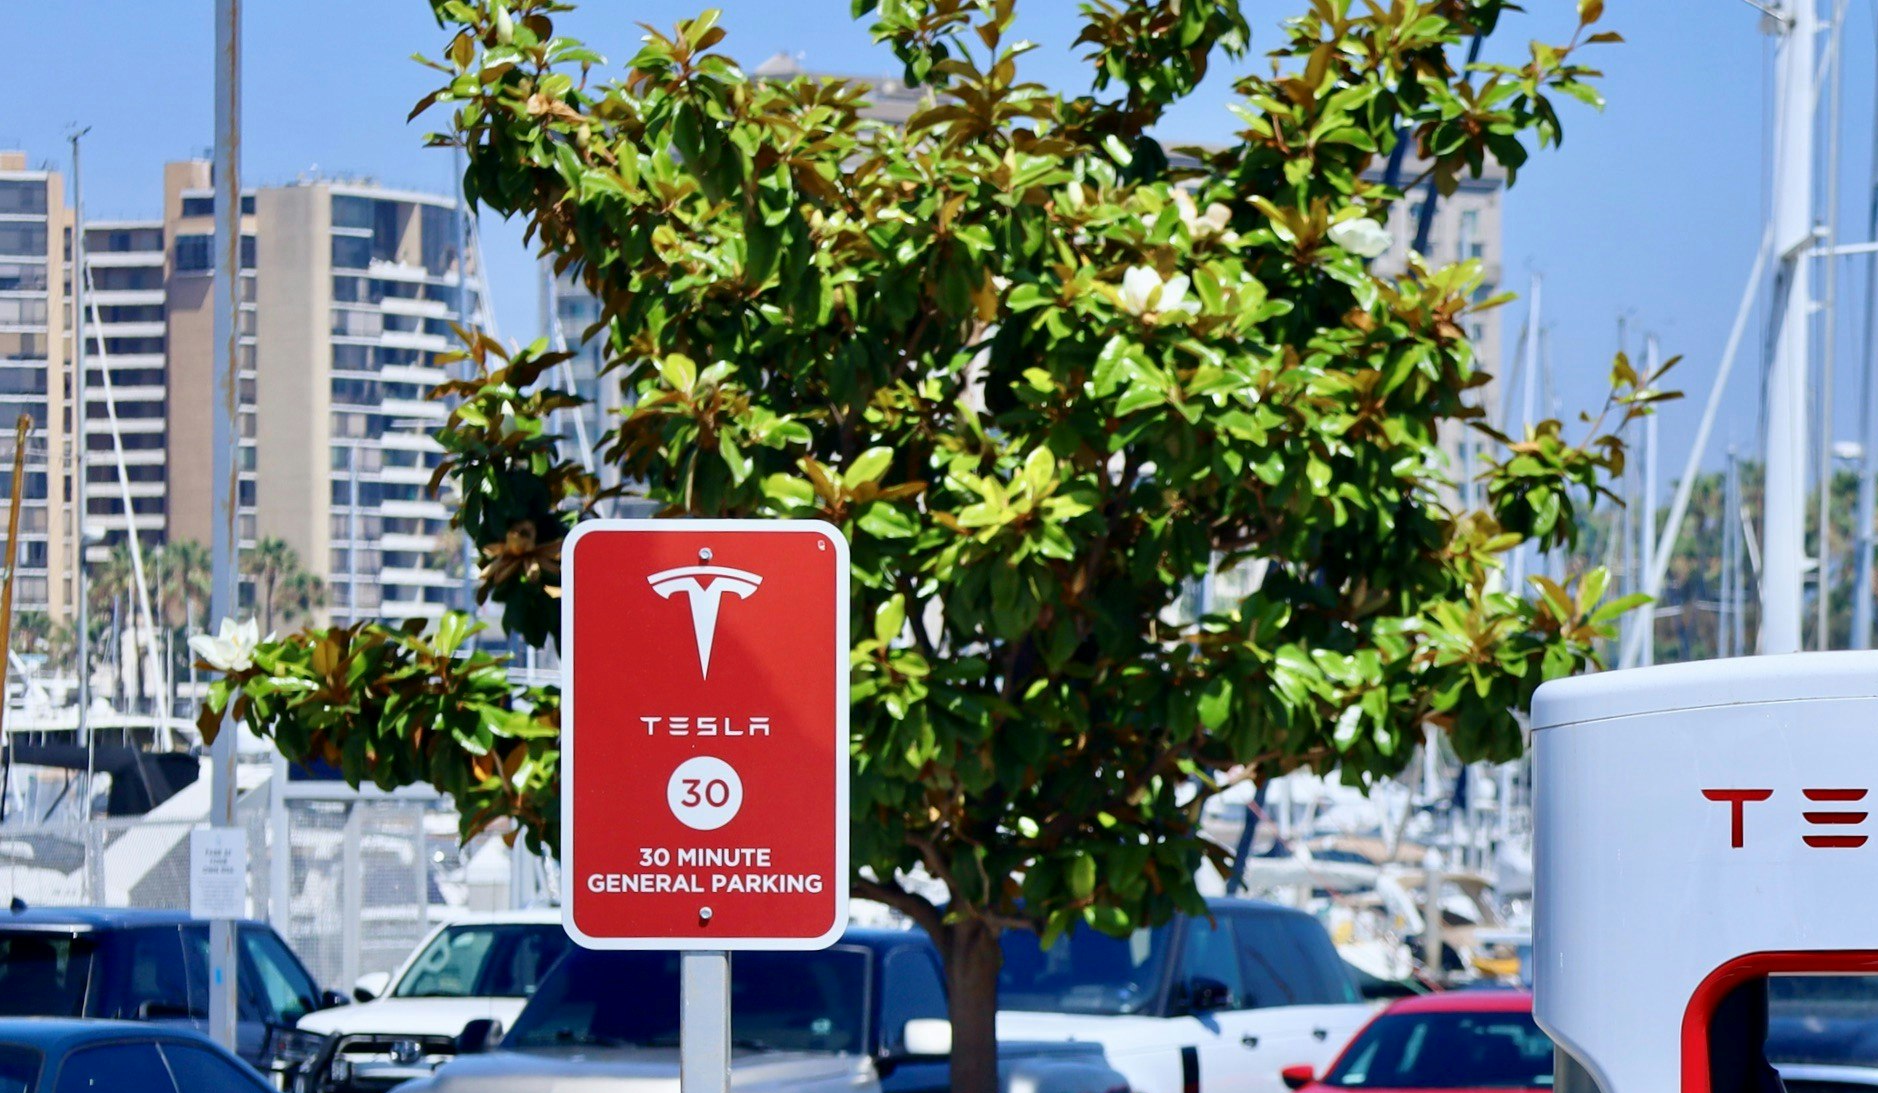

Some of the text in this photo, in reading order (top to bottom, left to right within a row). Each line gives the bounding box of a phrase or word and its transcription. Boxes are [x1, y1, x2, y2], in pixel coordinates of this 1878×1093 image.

[640, 716, 770, 736] TESLA
[681, 778, 730, 808] 30
[639, 847, 771, 867] 30 MINUTE
[587, 873, 823, 894] GENERAL PARKING
